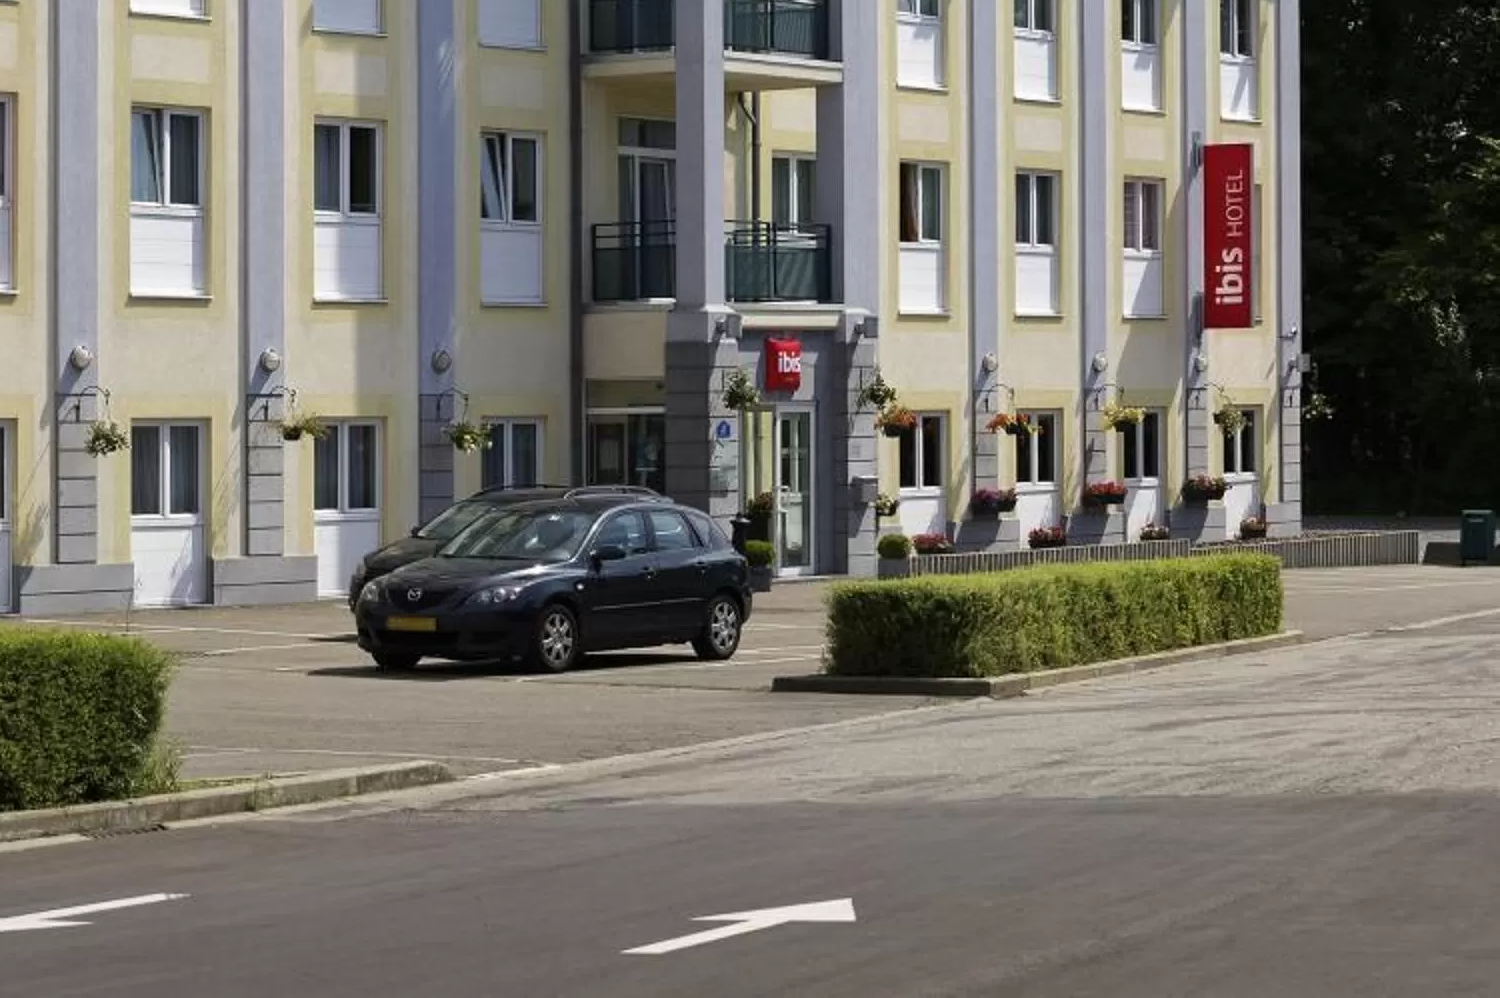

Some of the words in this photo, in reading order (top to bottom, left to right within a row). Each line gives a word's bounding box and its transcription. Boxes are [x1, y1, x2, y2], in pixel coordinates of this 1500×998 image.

[1225, 169, 1244, 237] HOTEL
[1215, 247, 1244, 305] ibis
[778, 351, 801, 373] ibis
